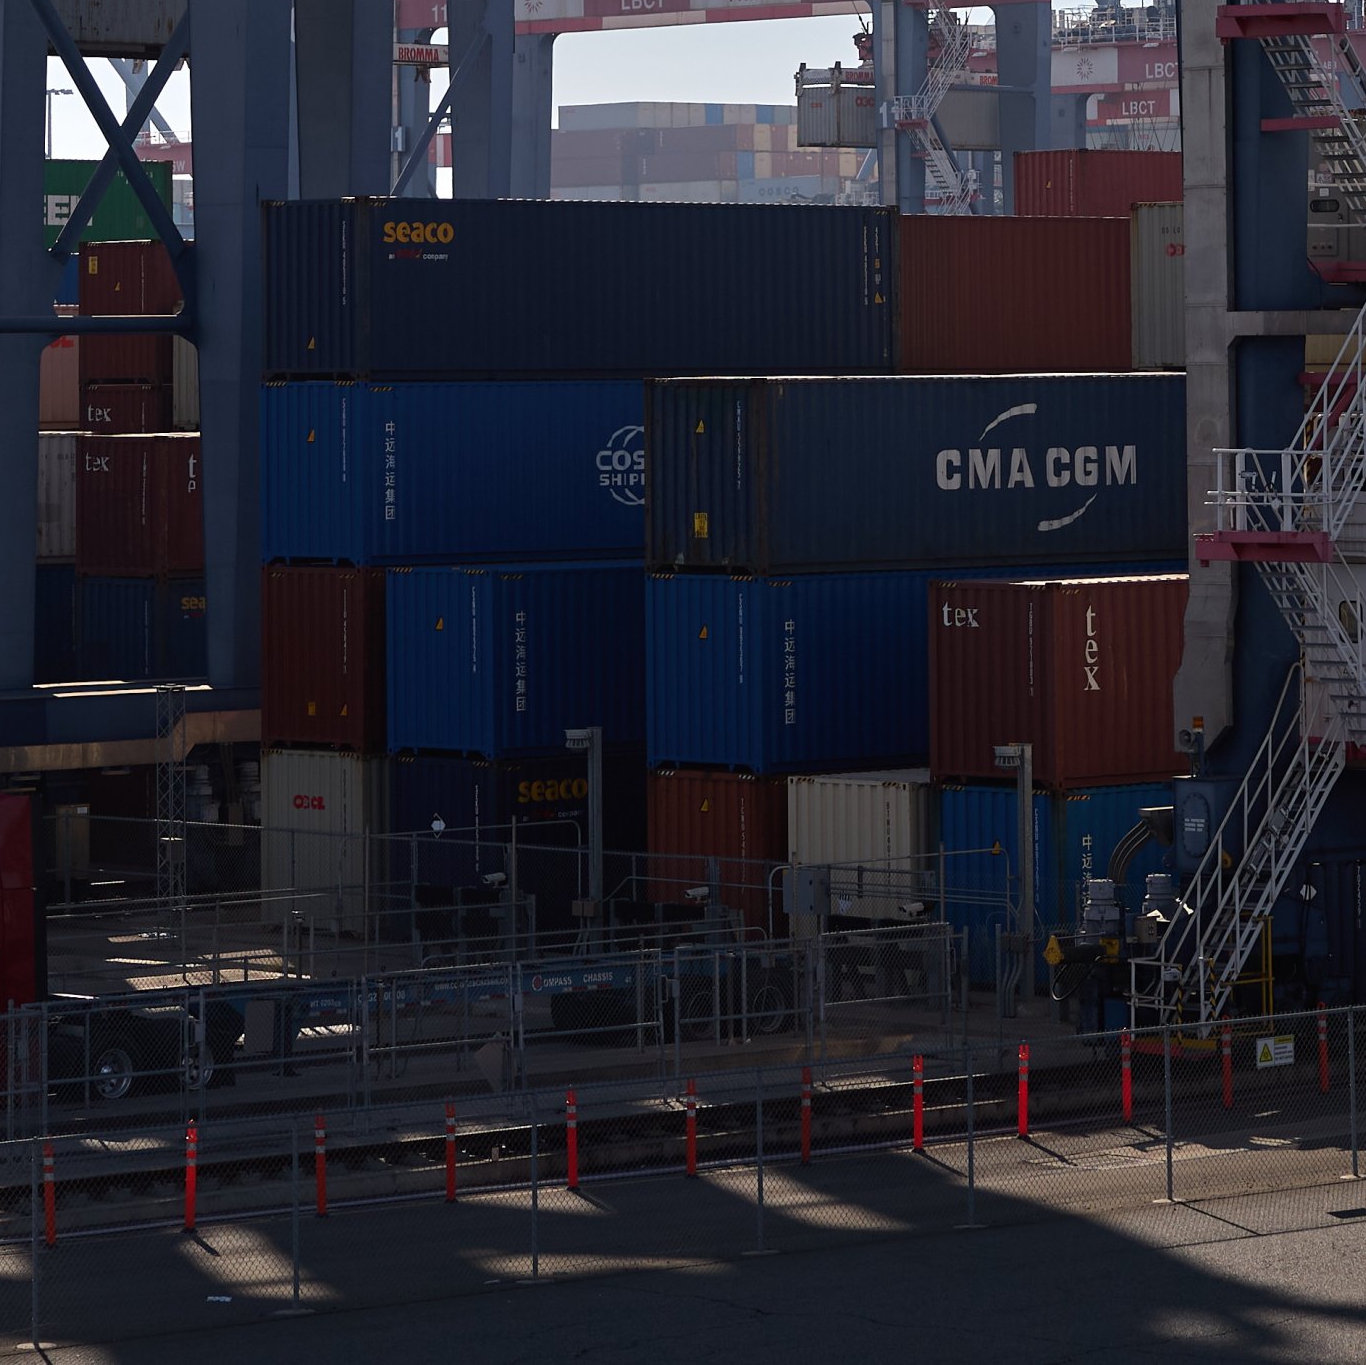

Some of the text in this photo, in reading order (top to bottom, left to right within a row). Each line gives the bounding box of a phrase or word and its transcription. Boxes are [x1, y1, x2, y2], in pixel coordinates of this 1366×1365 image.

[398, 46, 440, 62] BROMMA
[1145, 62, 1179, 78] LBC
[1122, 100, 1155, 116] LBCT
[383, 221, 454, 244] seaco
[87, 404, 112, 422] tex
[85, 451, 110, 472] tex
[385, 420, 395, 520] 中远海运集团
[595, 449, 645, 472] COS
[936, 445, 1136, 490] CMA CGM
[181, 595, 206, 610] sea
[942, 601, 979, 627] tex
[1083, 604, 1101, 690] tex
[515, 610, 527, 712] 中远海运集团
[784, 619, 795, 725] 中远海运集团
[517, 778, 588, 803] seaco
